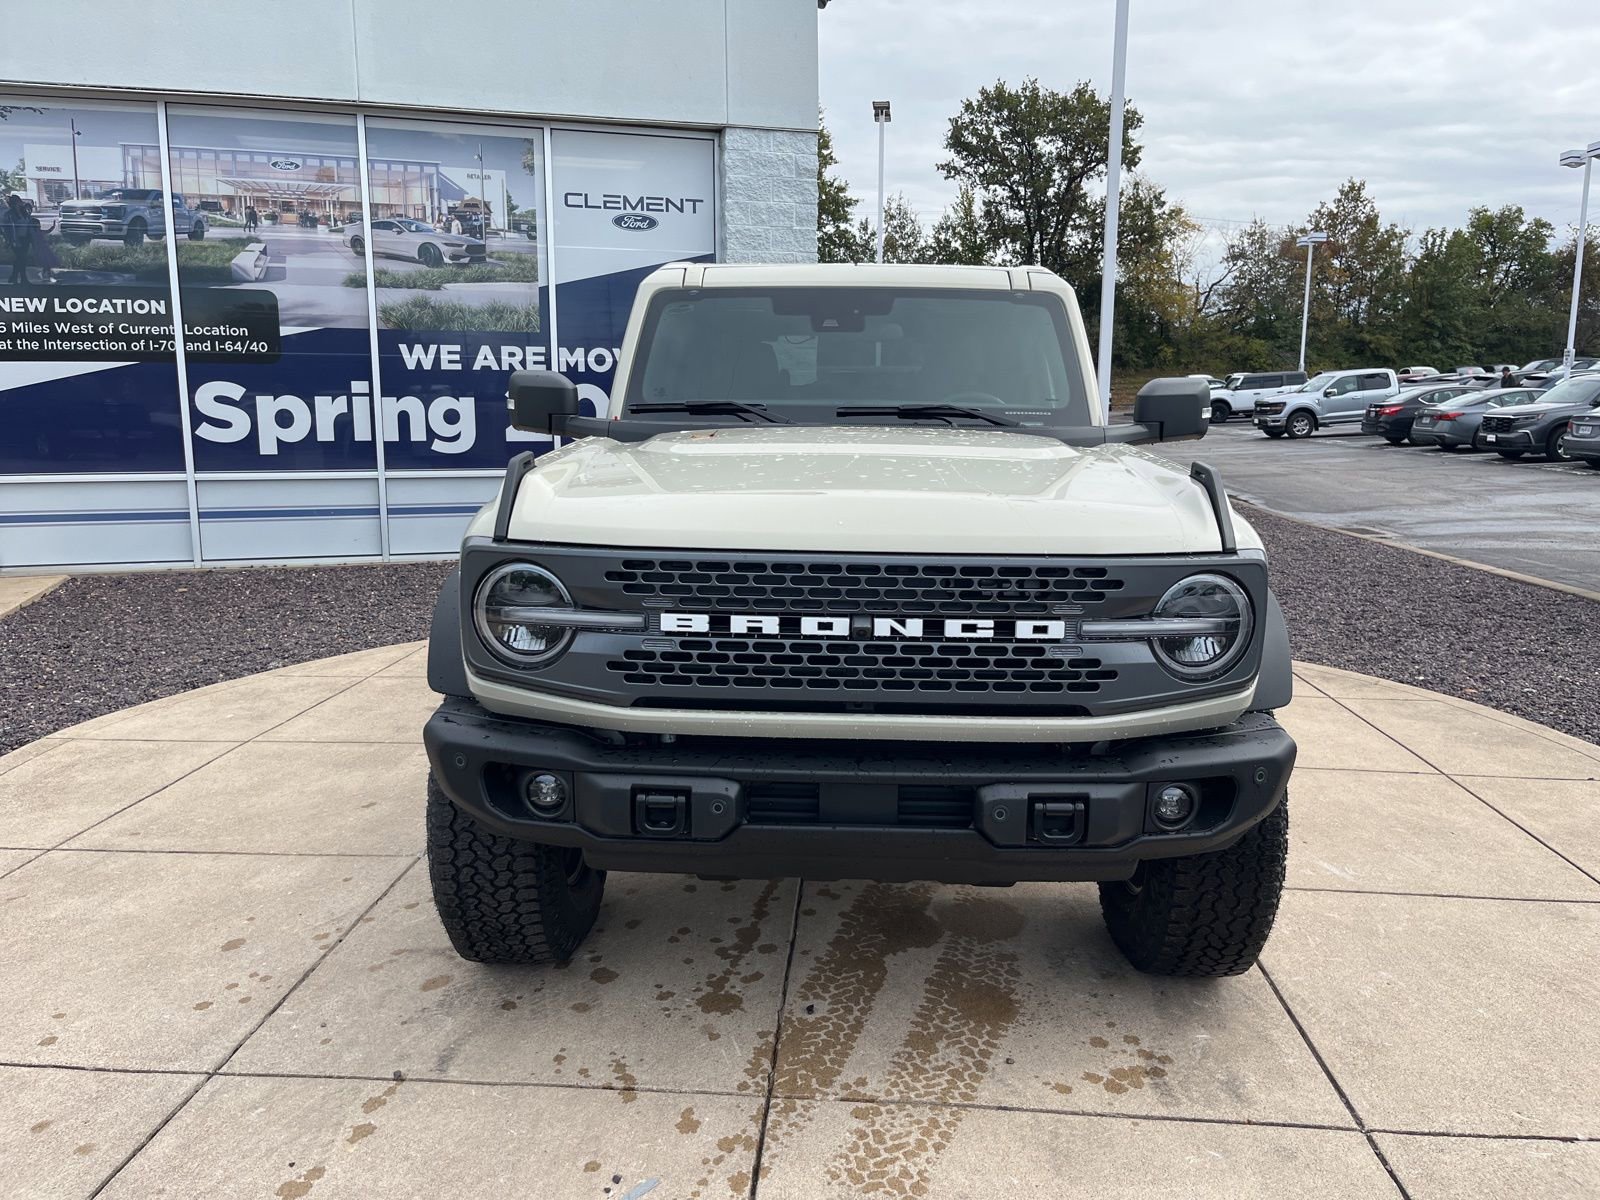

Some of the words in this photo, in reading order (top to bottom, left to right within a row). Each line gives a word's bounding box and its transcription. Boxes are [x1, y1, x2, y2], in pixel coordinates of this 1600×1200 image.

[564, 192, 704, 214] CLEMENT
[621, 215, 649, 229] Ford
[0, 297, 48, 313] NEW
[53, 298, 167, 315] LOCATION
[12, 322, 50, 333] Miles
[54, 322, 94, 334] West
[98, 322, 115, 334] of
[118, 323, 175, 335] Current
[184, 324, 249, 337] Location
[0, 339, 13, 350] at
[16, 338, 40, 350] the
[44, 338, 127, 351] Intersection
[131, 339, 146, 351] of
[149, 340, 176, 351] I-70
[185, 340, 211, 352] and
[215, 340, 269, 354] I-64/40
[399, 343, 463, 371] WE
[472, 345, 547, 371] ARE
[194, 380, 477, 456] Spring
[660, 612, 1066, 638] BRONCO
